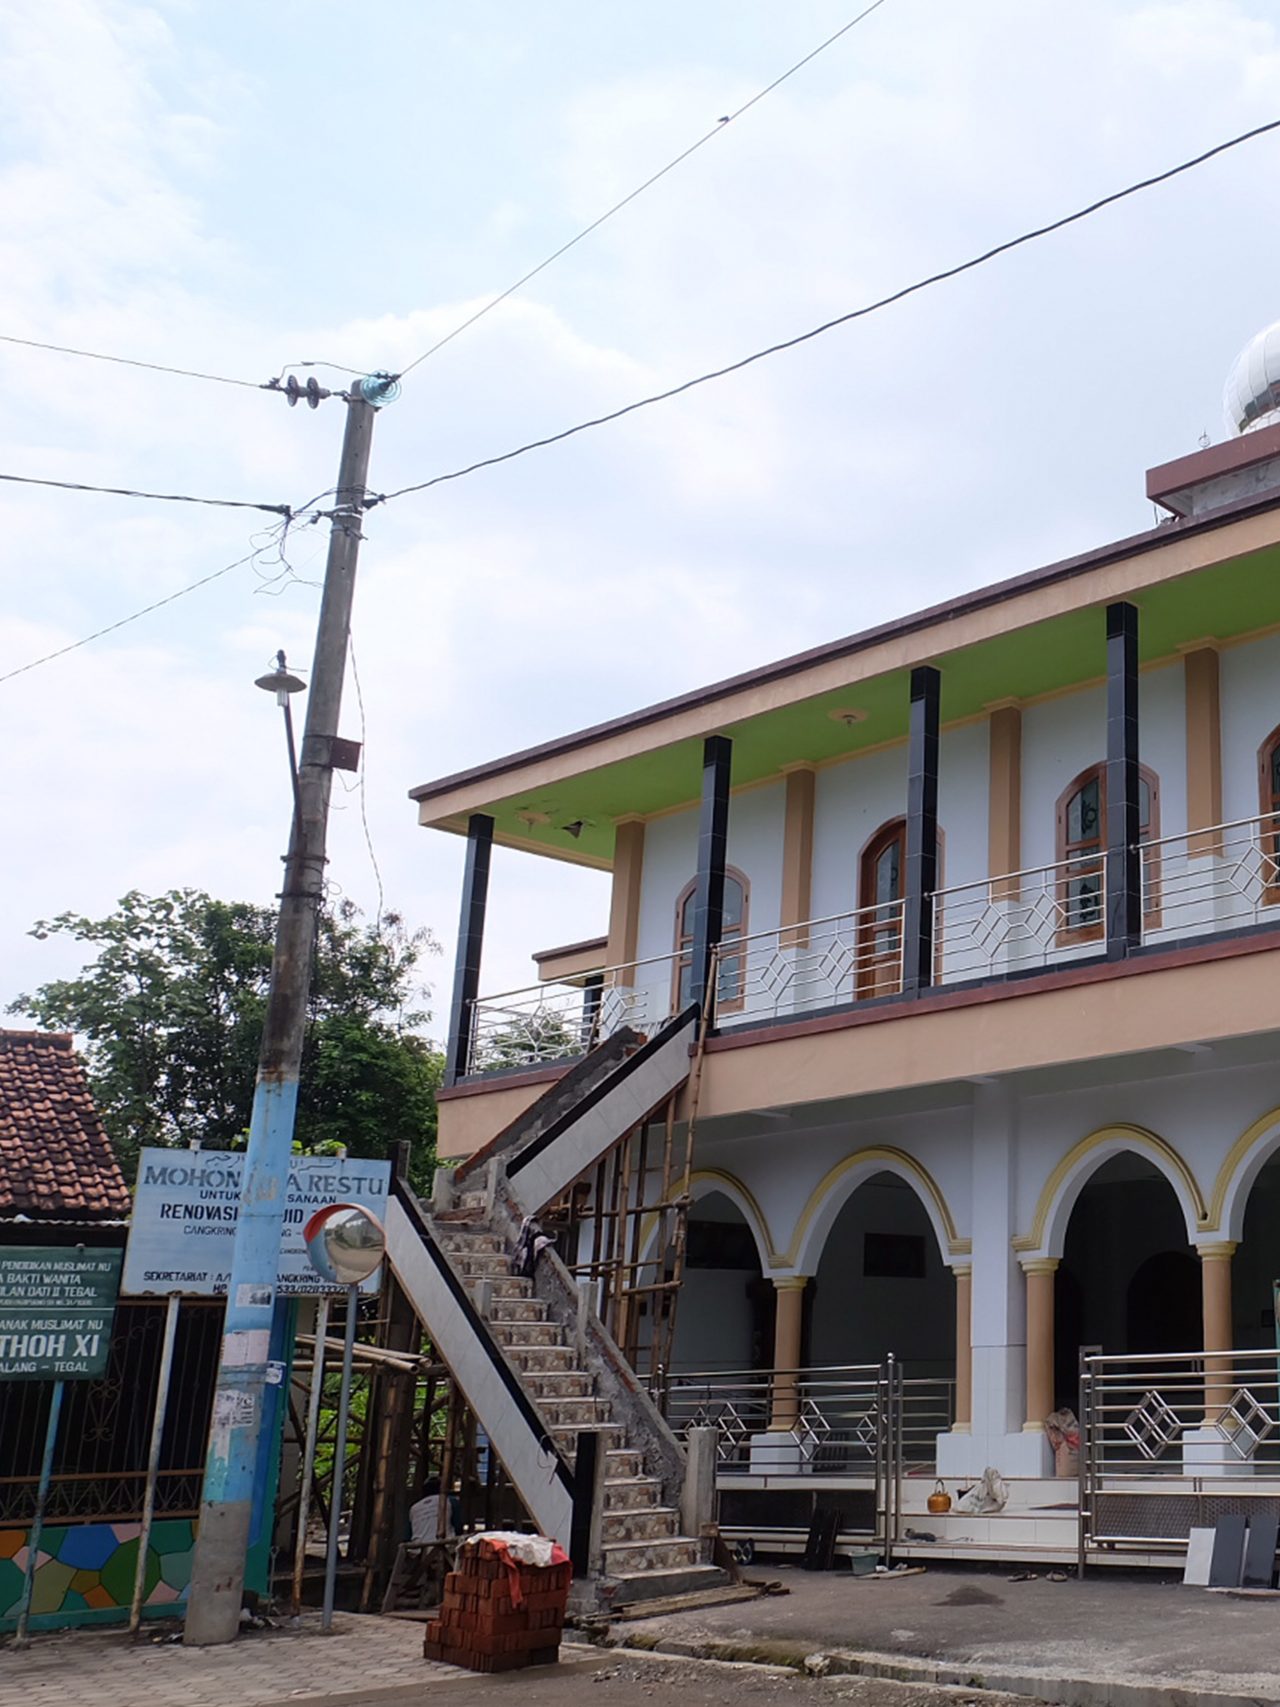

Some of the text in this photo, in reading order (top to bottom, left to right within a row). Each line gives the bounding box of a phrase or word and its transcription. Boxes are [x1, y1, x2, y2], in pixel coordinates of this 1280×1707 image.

[144, 1165, 241, 1189] MOHON
[308, 1174, 384, 1196] RESTU
[199, 1189, 336, 1204] UNTUK SANAAN
[160, 1203, 304, 1224] RENOVASI JID
[53, 1262, 96, 1272] MUSLIMAT
[97, 1263, 112, 1272] NU
[7, 1273, 40, 1284] BAKTI
[42, 1274, 82, 1285] WANITA
[276, 1273, 321, 1283] ANGKRING
[0, 1319, 104, 1331] ANAK MUSLIMAT NU
[0, 1333, 100, 1358] THOH XI
[0, 1361, 37, 1373] ALANG
[54, 1361, 89, 1373] TEGAL
